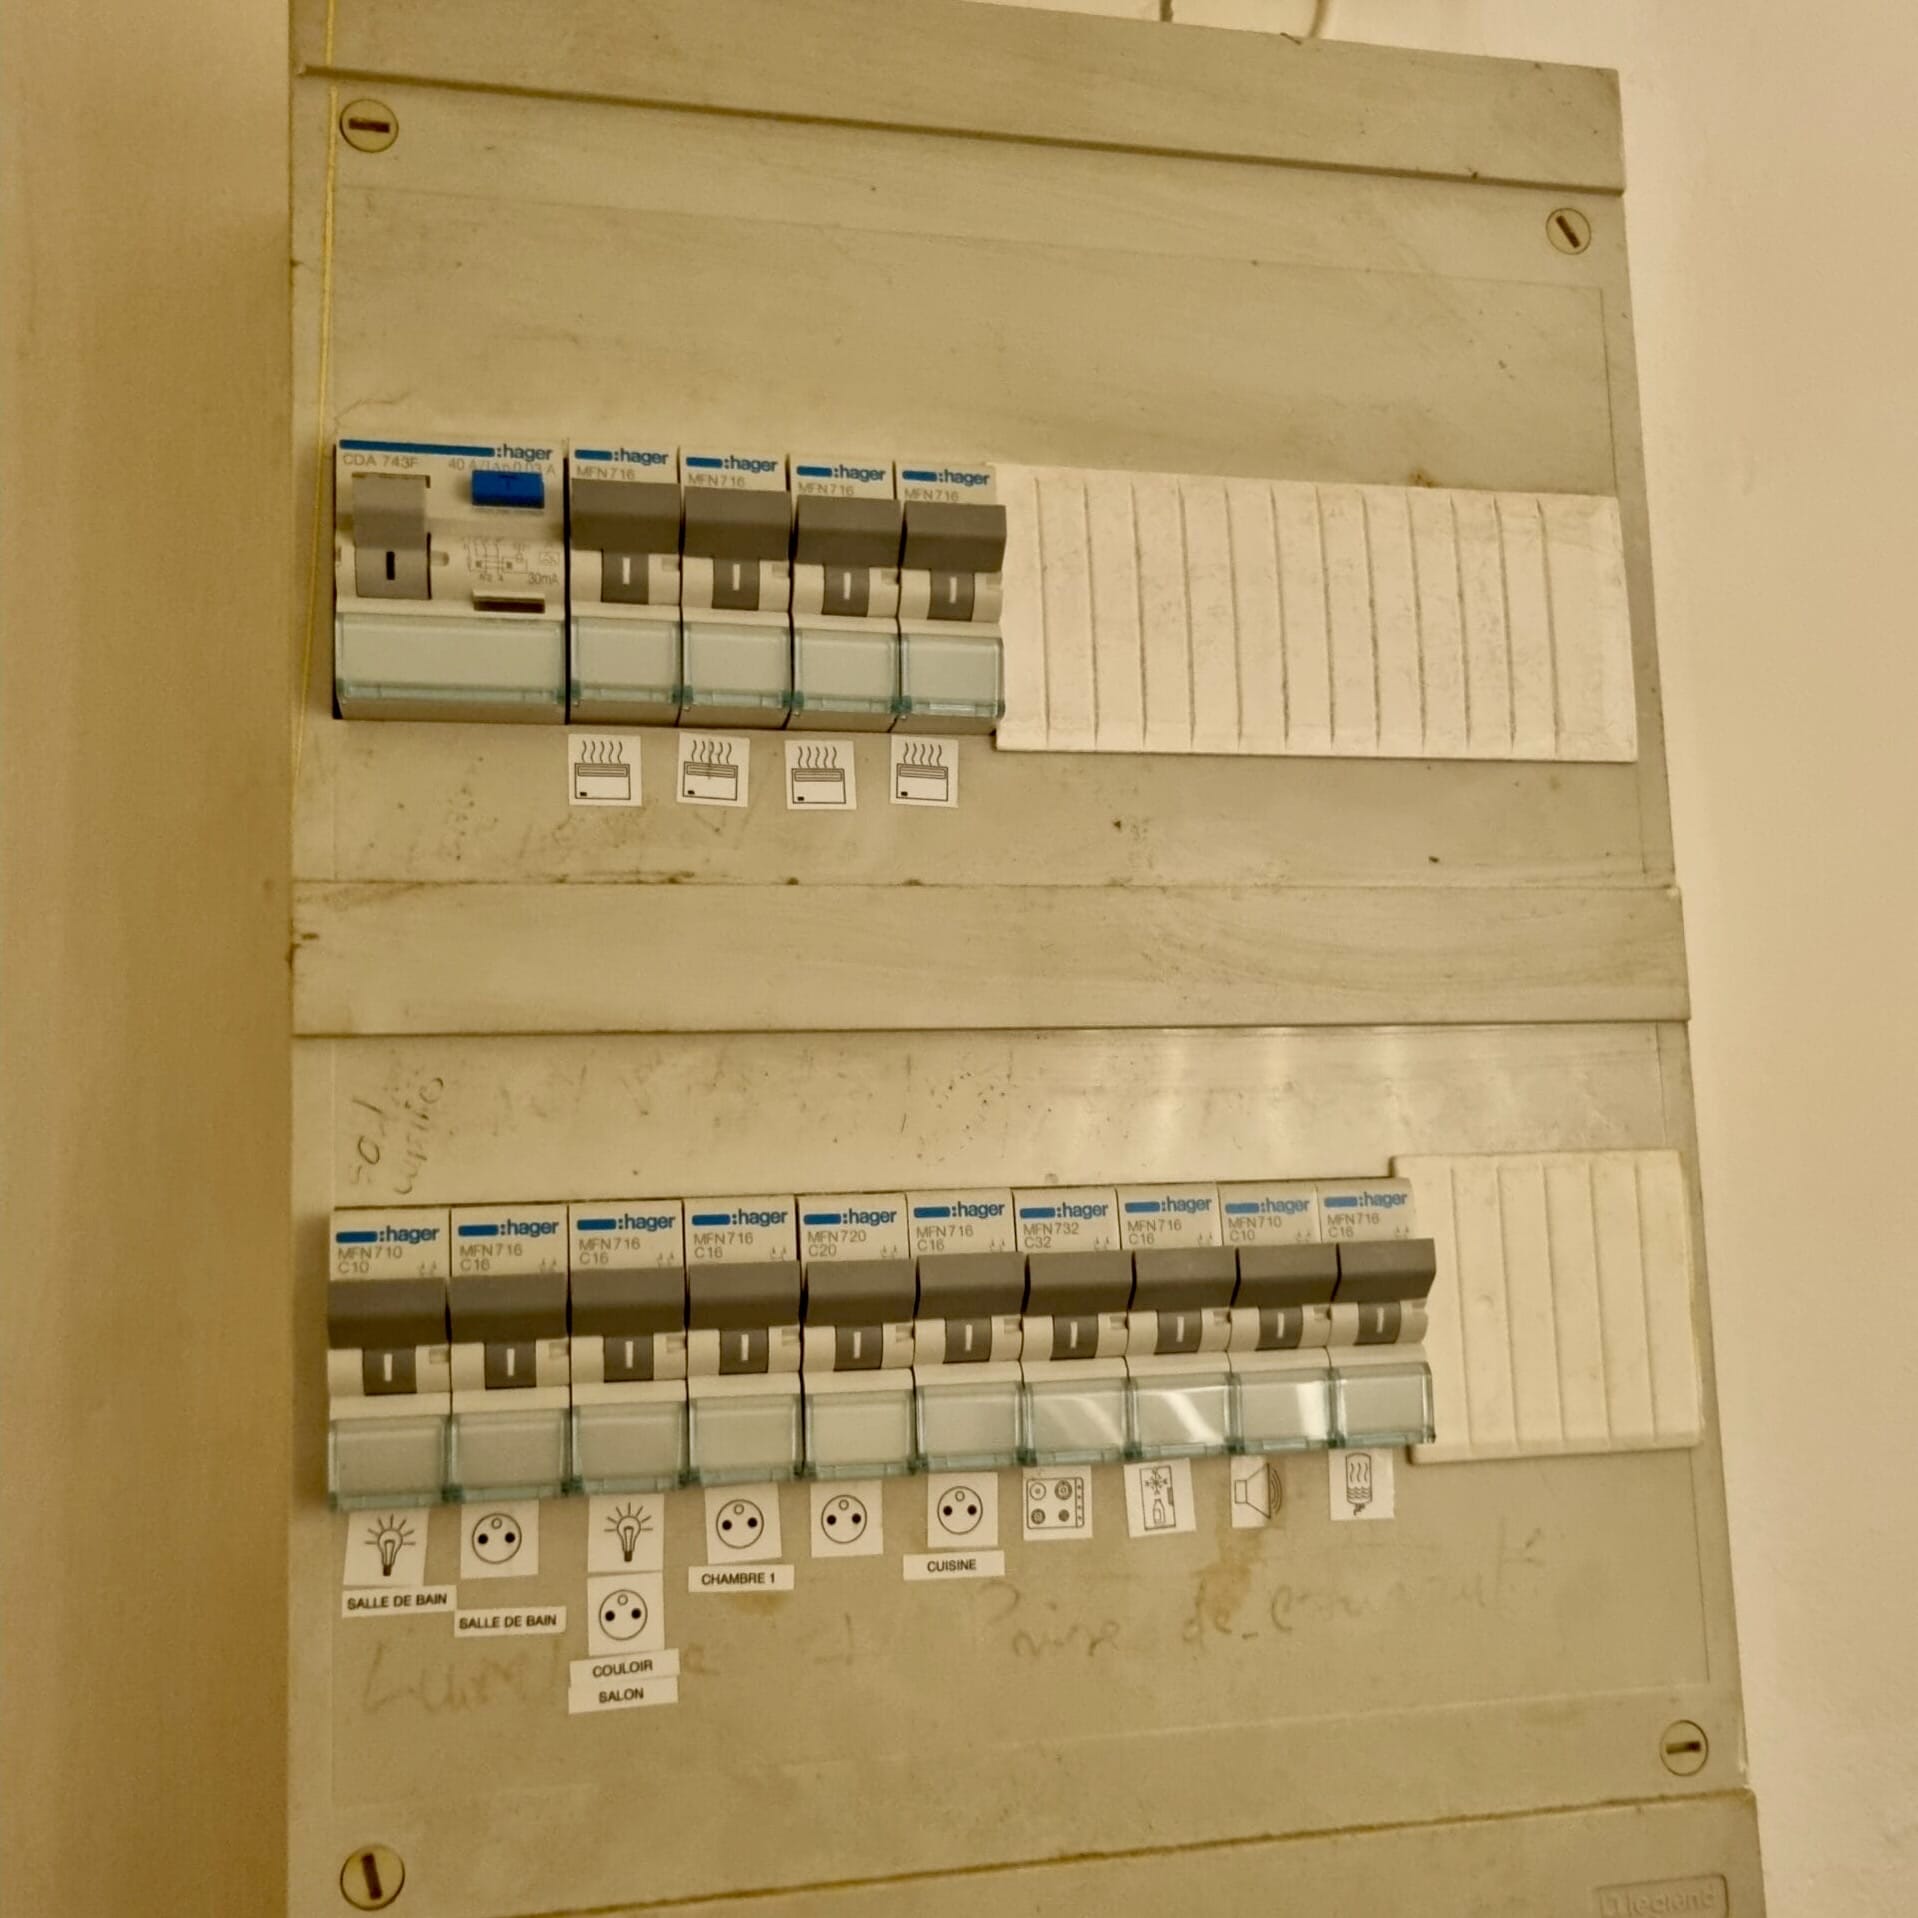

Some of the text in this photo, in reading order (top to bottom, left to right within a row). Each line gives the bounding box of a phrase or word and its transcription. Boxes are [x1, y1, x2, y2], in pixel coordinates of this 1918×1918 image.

[342, 455, 419, 469] CDA 743F
[447, 457, 465, 471] 40
[1128, 1233, 1155, 1246] C16
[1229, 1229, 1256, 1242] C10
[1328, 1226, 1354, 1239] C16
[917, 1239, 945, 1252] C16
[1024, 1236, 1052, 1249] C32
[694, 1246, 724, 1260] C16
[808, 1244, 837, 1257] C20
[459, 1258, 491, 1272] C16
[579, 1251, 609, 1265] C16
[337, 1260, 370, 1274] C10
[926, 1558, 977, 1574] CUISINE
[701, 1572, 776, 1586] CHAMBRE 1
[347, 1593, 448, 1610] SALLE DE BAIN
[459, 1614, 557, 1630] SALLE DE BAIN
[592, 1659, 653, 1678] COULOIR
[598, 1687, 644, 1704] SALON
